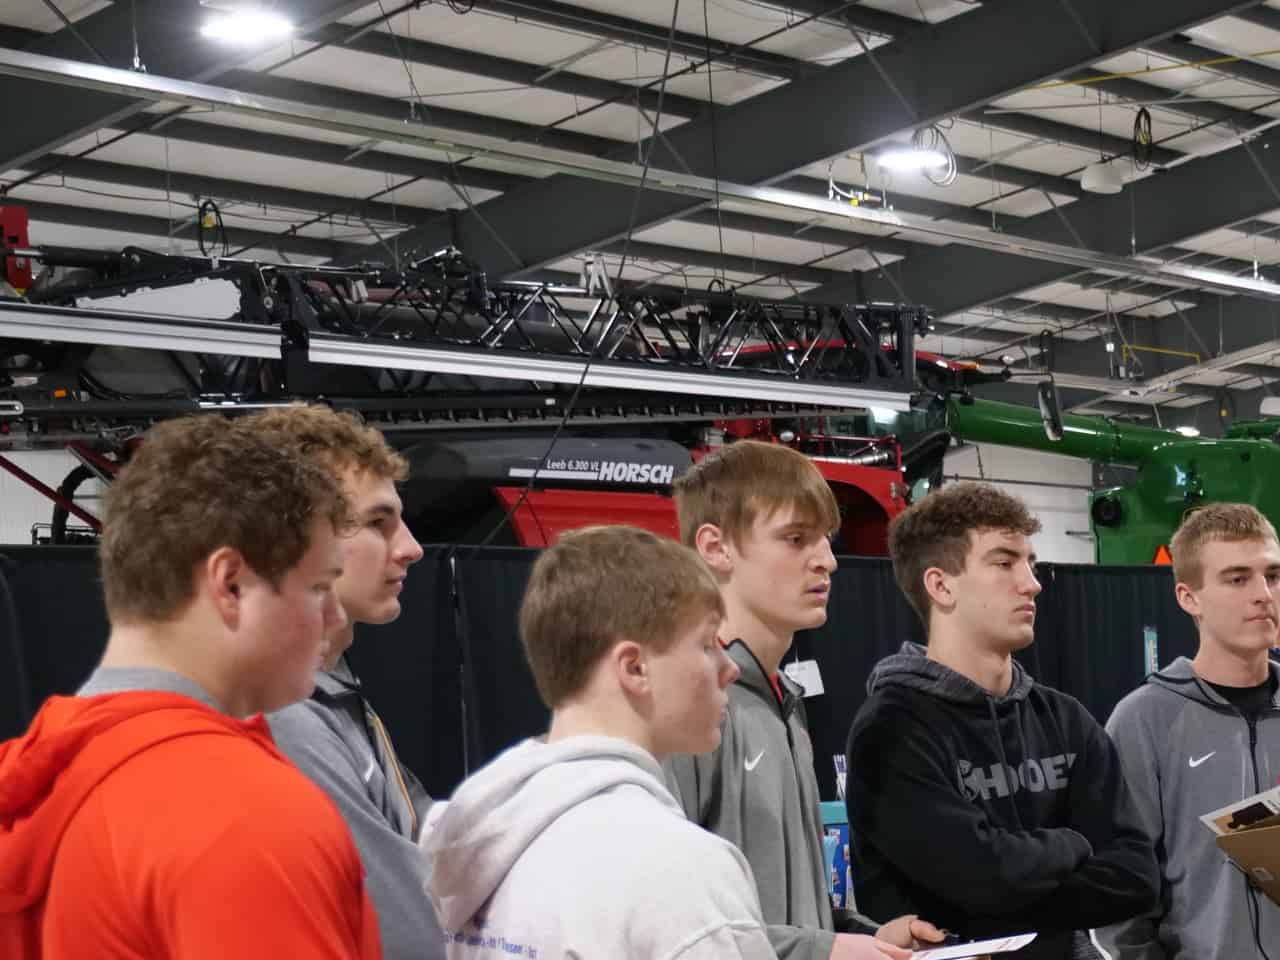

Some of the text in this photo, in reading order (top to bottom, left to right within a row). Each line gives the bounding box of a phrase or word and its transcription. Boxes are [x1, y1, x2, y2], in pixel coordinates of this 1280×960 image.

[546, 459, 567, 470] Leeb
[567, 460, 589, 471] 6.300
[599, 461, 675, 484] HORSCH
